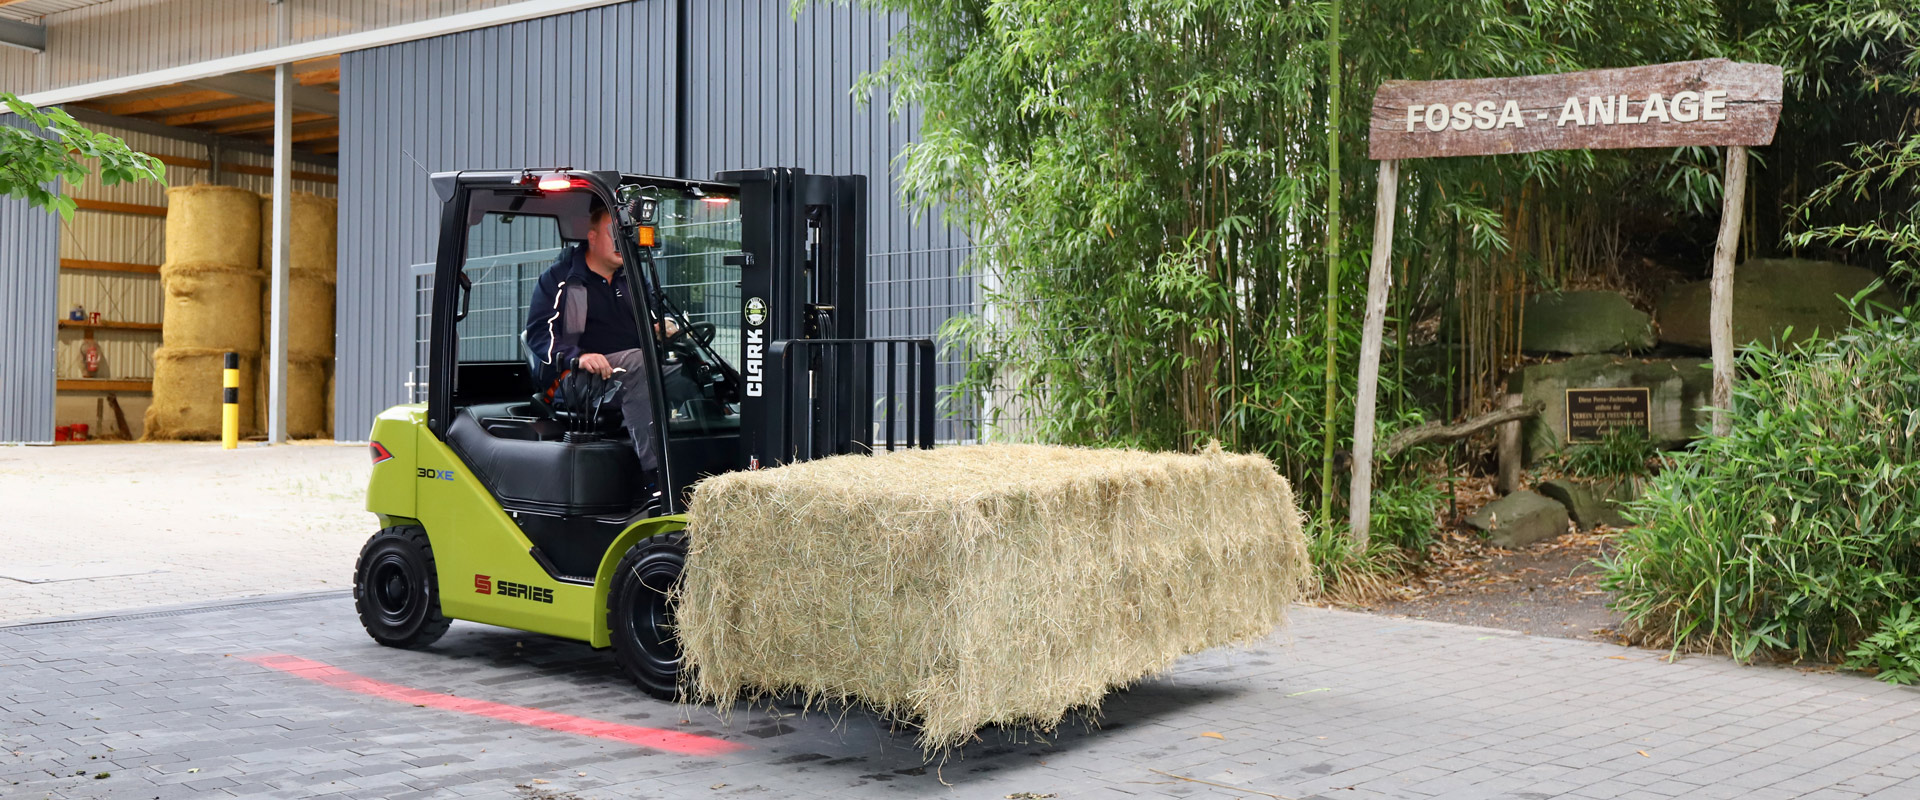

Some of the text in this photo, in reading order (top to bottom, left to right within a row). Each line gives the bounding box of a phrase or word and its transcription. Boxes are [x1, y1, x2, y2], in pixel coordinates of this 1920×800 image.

[1406, 100, 1525, 133] FOSSA
[1557, 90, 1728, 127] ANLAGE
[746, 329, 763, 397] CLARK
[417, 467, 455, 481] 30XE
[496, 580, 554, 604] SERIES
